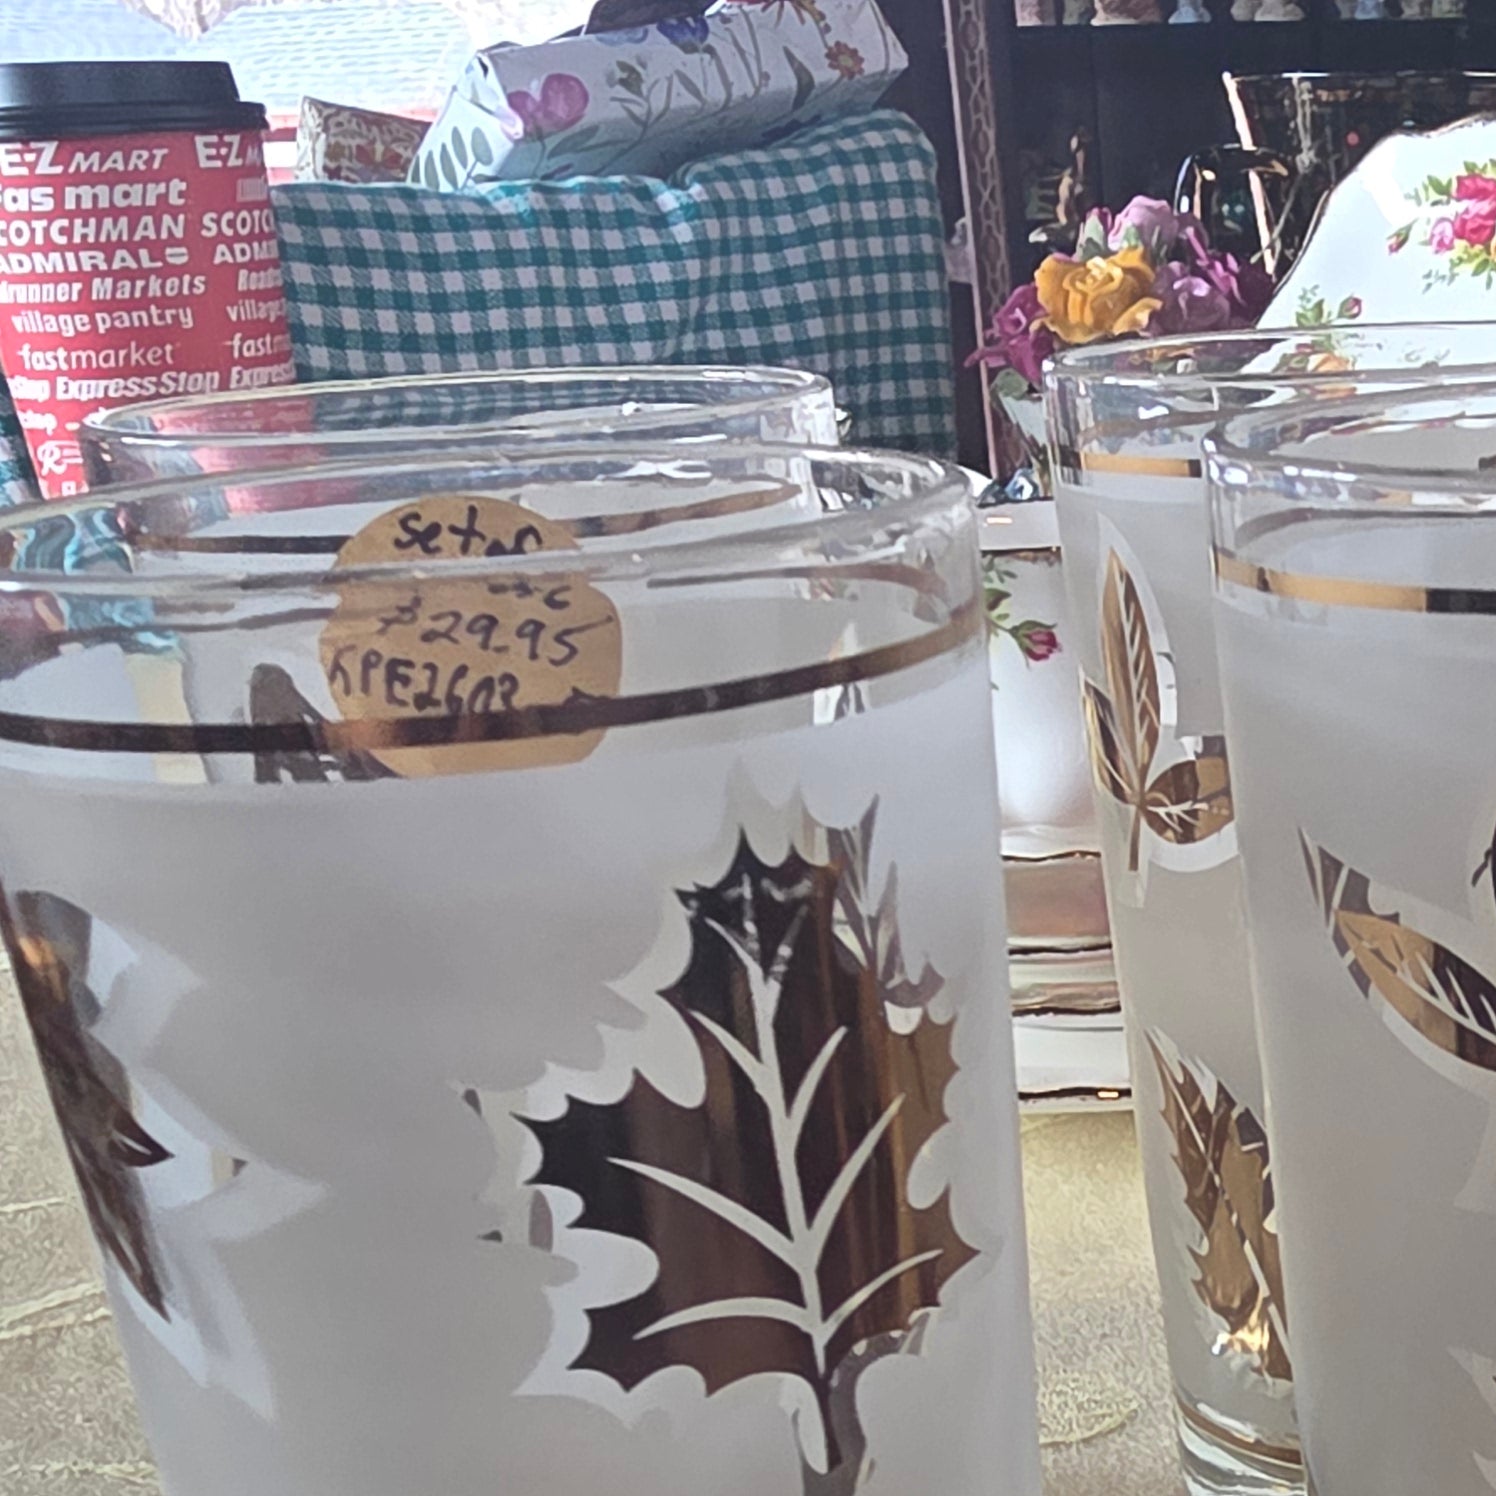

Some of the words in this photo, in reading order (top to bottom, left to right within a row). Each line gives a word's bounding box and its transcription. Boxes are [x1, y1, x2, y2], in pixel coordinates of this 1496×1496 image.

[68, 148, 169, 174] MART
[194, 134, 243, 168] E-Z
[64, 178, 187, 210] mart
[91, 273, 206, 300] Markets
[11, 310, 91, 337] village
[95, 304, 194, 335] pantry
[376, 595, 615, 668] $29.95
